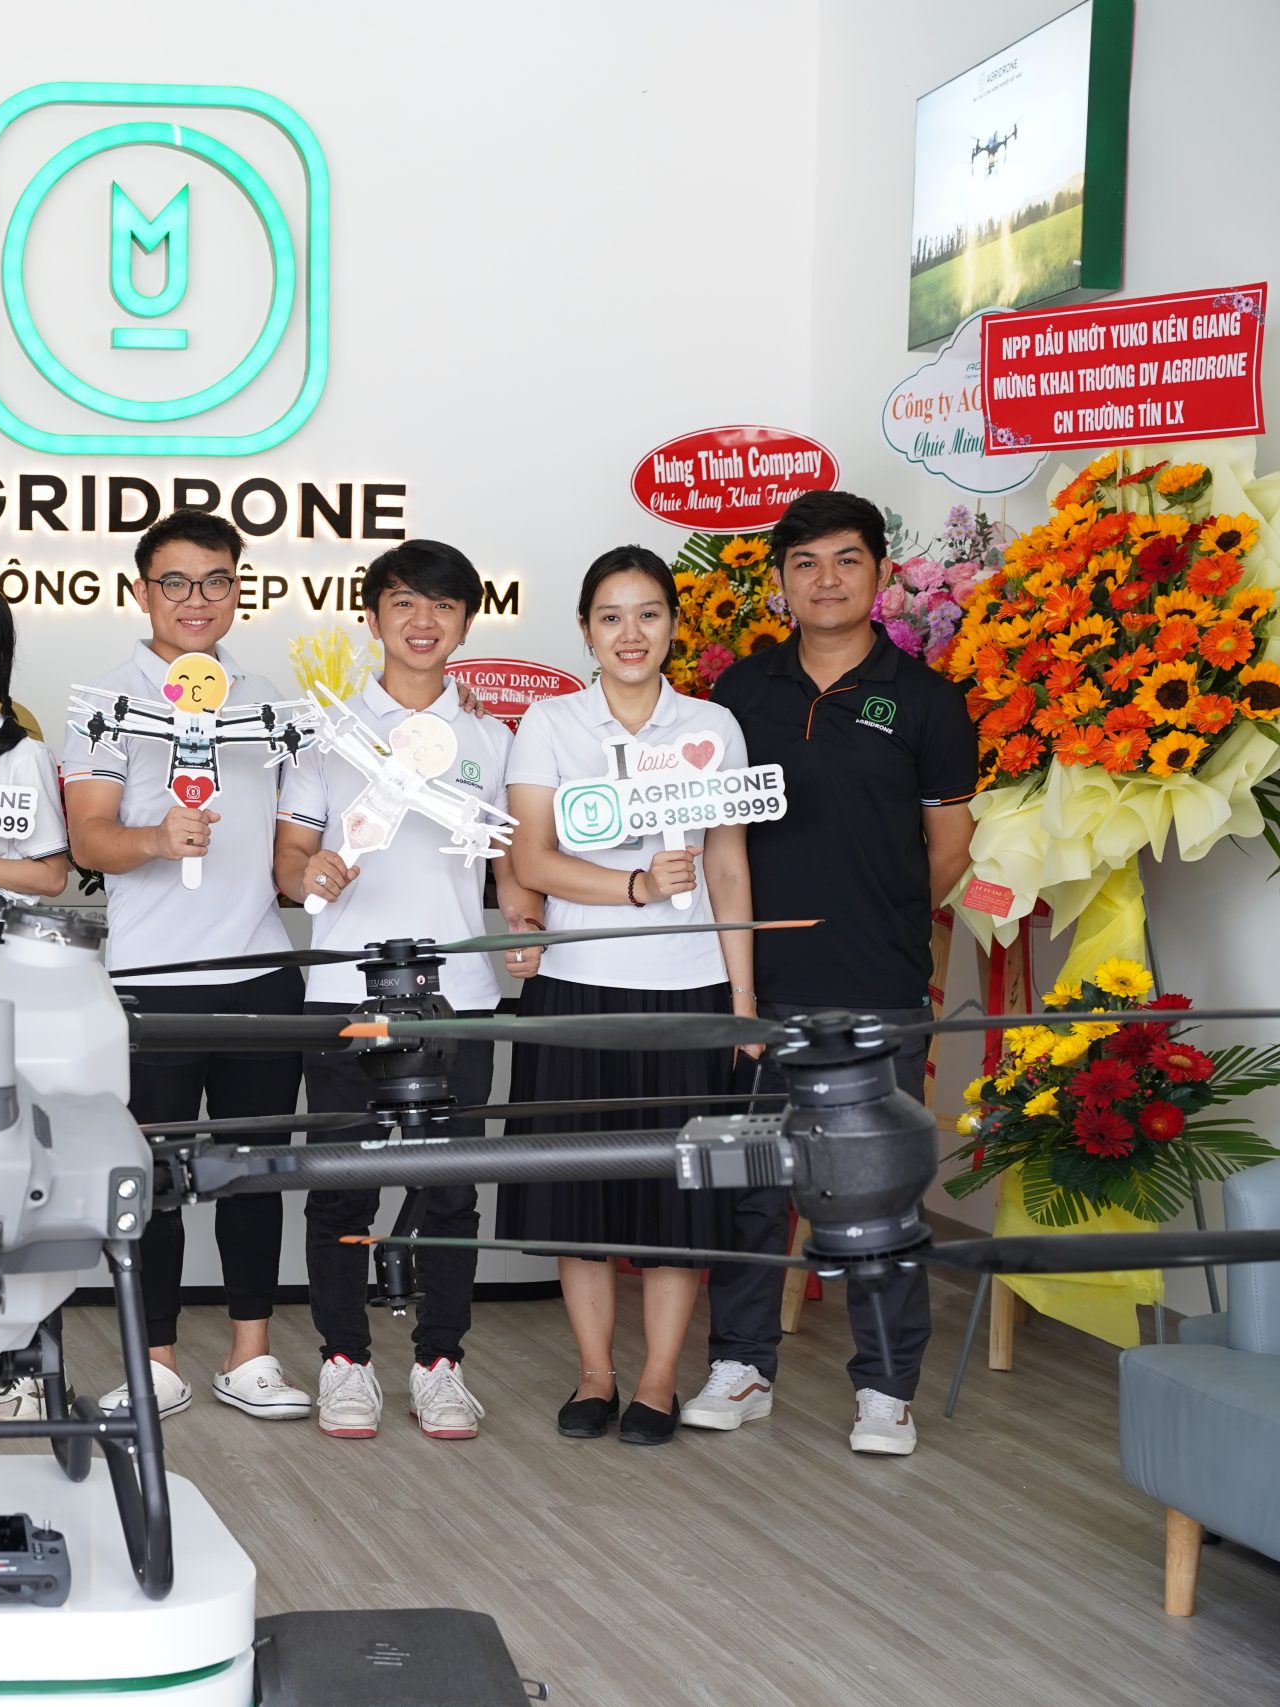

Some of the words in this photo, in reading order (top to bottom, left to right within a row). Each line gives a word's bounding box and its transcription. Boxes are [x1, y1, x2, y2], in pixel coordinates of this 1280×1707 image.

[1002, 334, 1031, 361] NPP
[1034, 324, 1064, 357] DẦU
[1067, 322, 1107, 353] NHỚT
[1109, 321, 1148, 349] YUKO
[1152, 314, 1189, 344] KIÊN
[1192, 311, 1241, 341] GIANG
[993, 369, 1037, 401] MỪNG
[1039, 367, 1074, 397] KHAI
[1078, 363, 1135, 393] TRƯƠNG
[1138, 361, 1159, 387] DV
[1161, 351, 1248, 385] AGRIDRONE
[892, 392, 934, 424] Công
[938, 391, 954, 422] ty
[1053, 411, 1074, 434] CN
[1077, 404, 1135, 433] TRƯỜNG
[1136, 399, 1163, 428] TÍN
[1166, 400, 1184, 425] LX
[914, 431, 946, 458] Chúc
[653, 453, 695, 488] Hưng
[698, 448, 744, 487] Thịnh
[747, 446, 823, 481] Company
[650, 490, 682, 513] Chúc
[726, 486, 762, 508] Khai
[301, 566, 365, 623] VIỆ
[448, 670, 471, 684] SAI
[475, 671, 507, 686] GON
[509, 673, 560, 689] DRONE
[500, 687, 525, 703] Khai
[855, 718, 894, 735] AGRIDRONE
[610, 743, 633, 781] I
[637, 750, 679, 773] love
[628, 771, 778, 806] AGRIDRONE
[629, 811, 658, 830] 03
[664, 805, 717, 826] 3838
[723, 797, 780, 819] 9999
